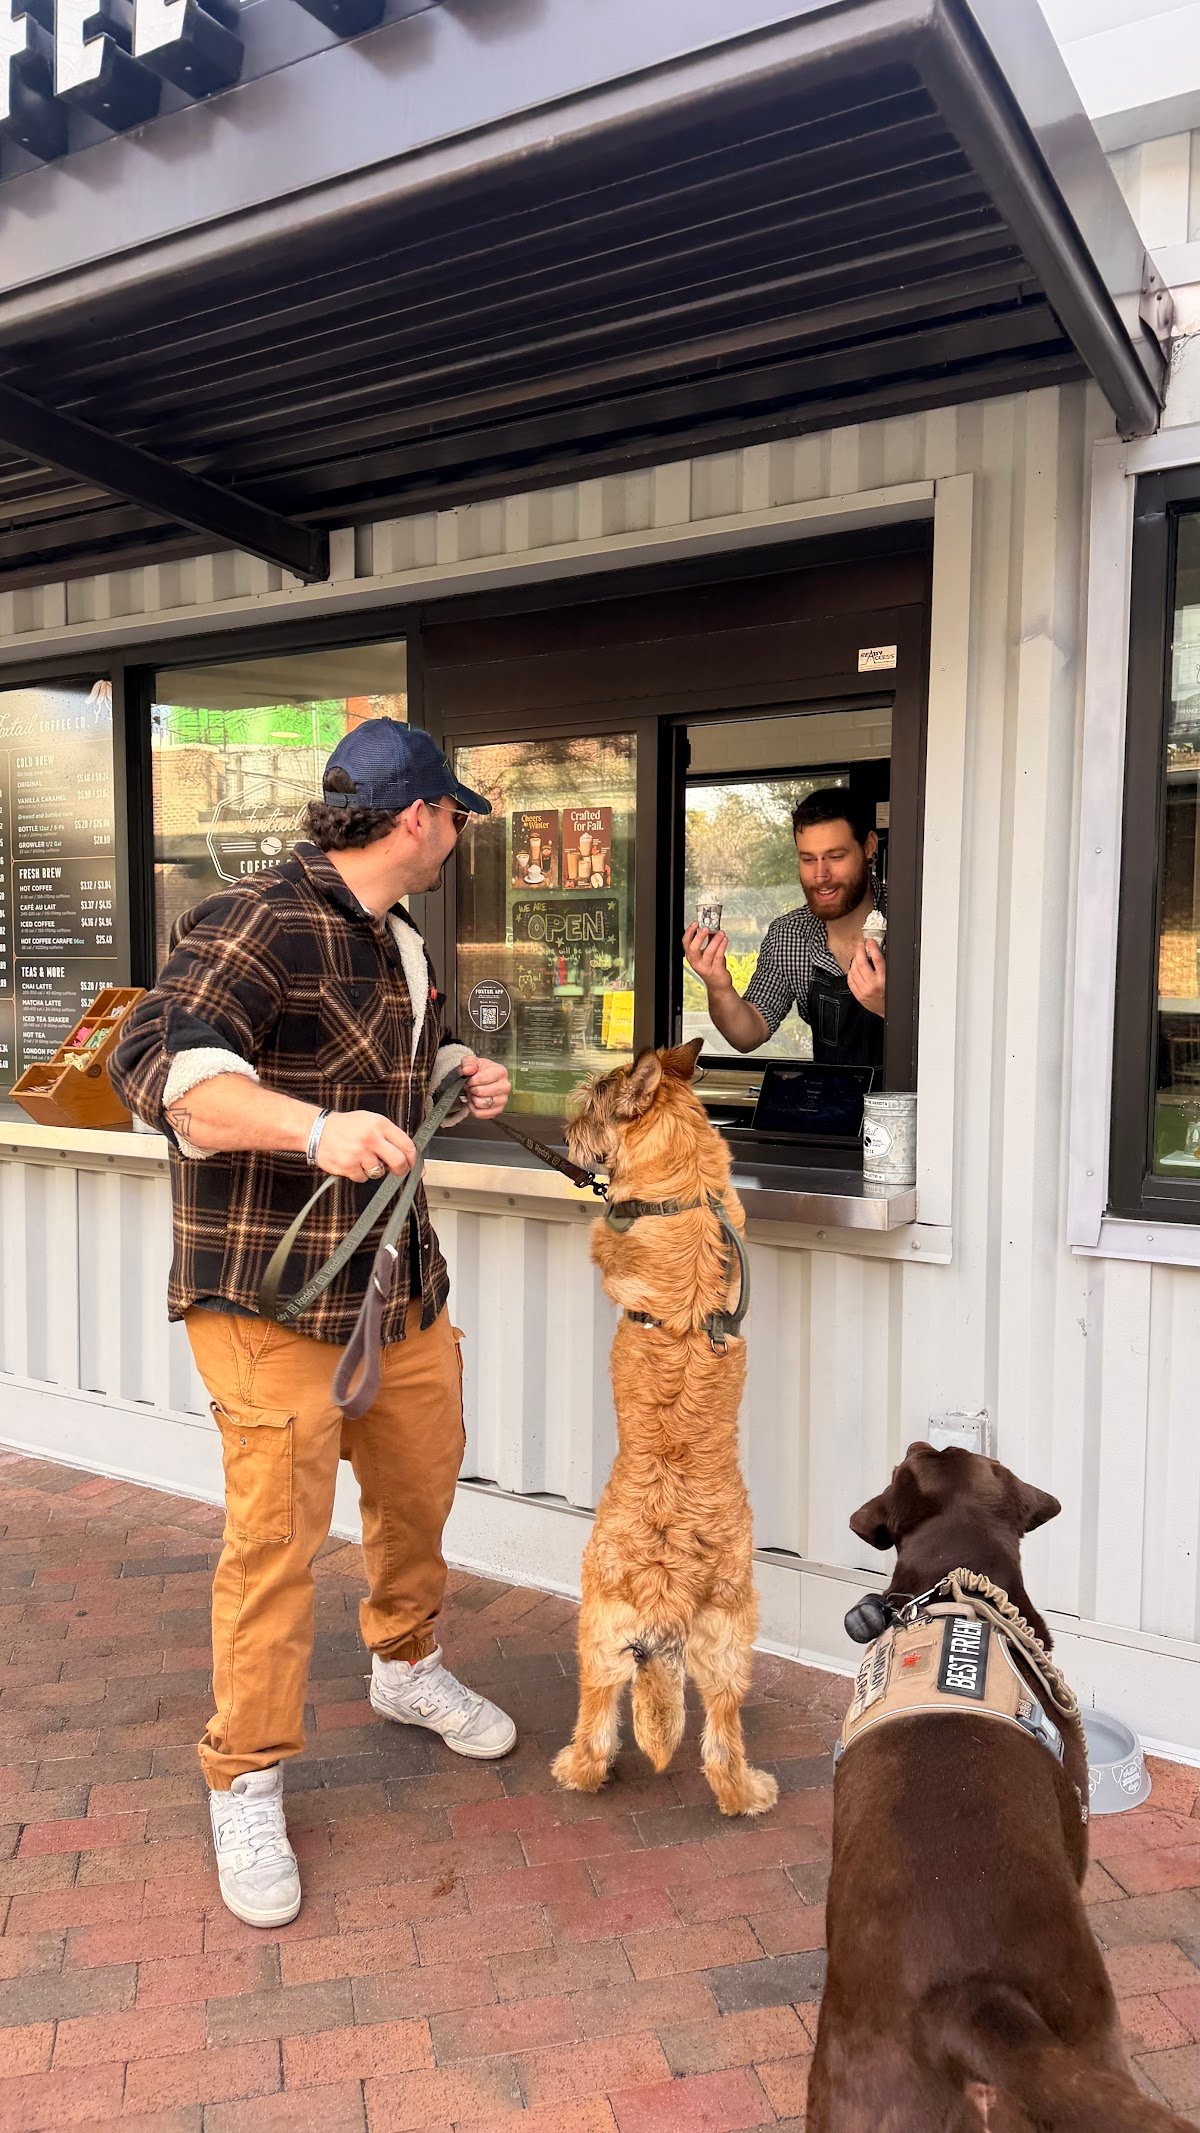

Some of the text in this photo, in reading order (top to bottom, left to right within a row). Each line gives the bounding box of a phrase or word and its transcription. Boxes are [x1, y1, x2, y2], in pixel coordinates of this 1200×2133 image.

[40, 717, 71, 733] COFFEE
[16, 755, 55, 768] COLD BREW
[17, 795, 66, 804] VANILLA CARAMEL
[521, 814, 542, 824] Cheers
[570, 810, 601, 821] Crafted
[18, 825, 38, 833] BOTTLE
[529, 821, 550, 830] Winter
[573, 820, 604, 832] for Fall.
[18, 841, 45, 849] GROWLER
[19, 867, 62, 879] FRESH BREW
[80, 881, 93, 891] $3.12
[20, 903, 34, 911] CAFÉ
[519, 904, 531, 913] WE
[528, 911, 605, 942] OPEN
[21, 966, 65, 978] TEAS & MORE
[80, 981, 94, 991] $5.20
[534, 1143, 552, 1161] Reddy
[325, 1250, 348, 1275] Reddy
[295, 1285, 319, 1307] Reddy
[276, 1311, 291, 1323] ddy
[945, 1617, 984, 1691] BEST FRIEN
